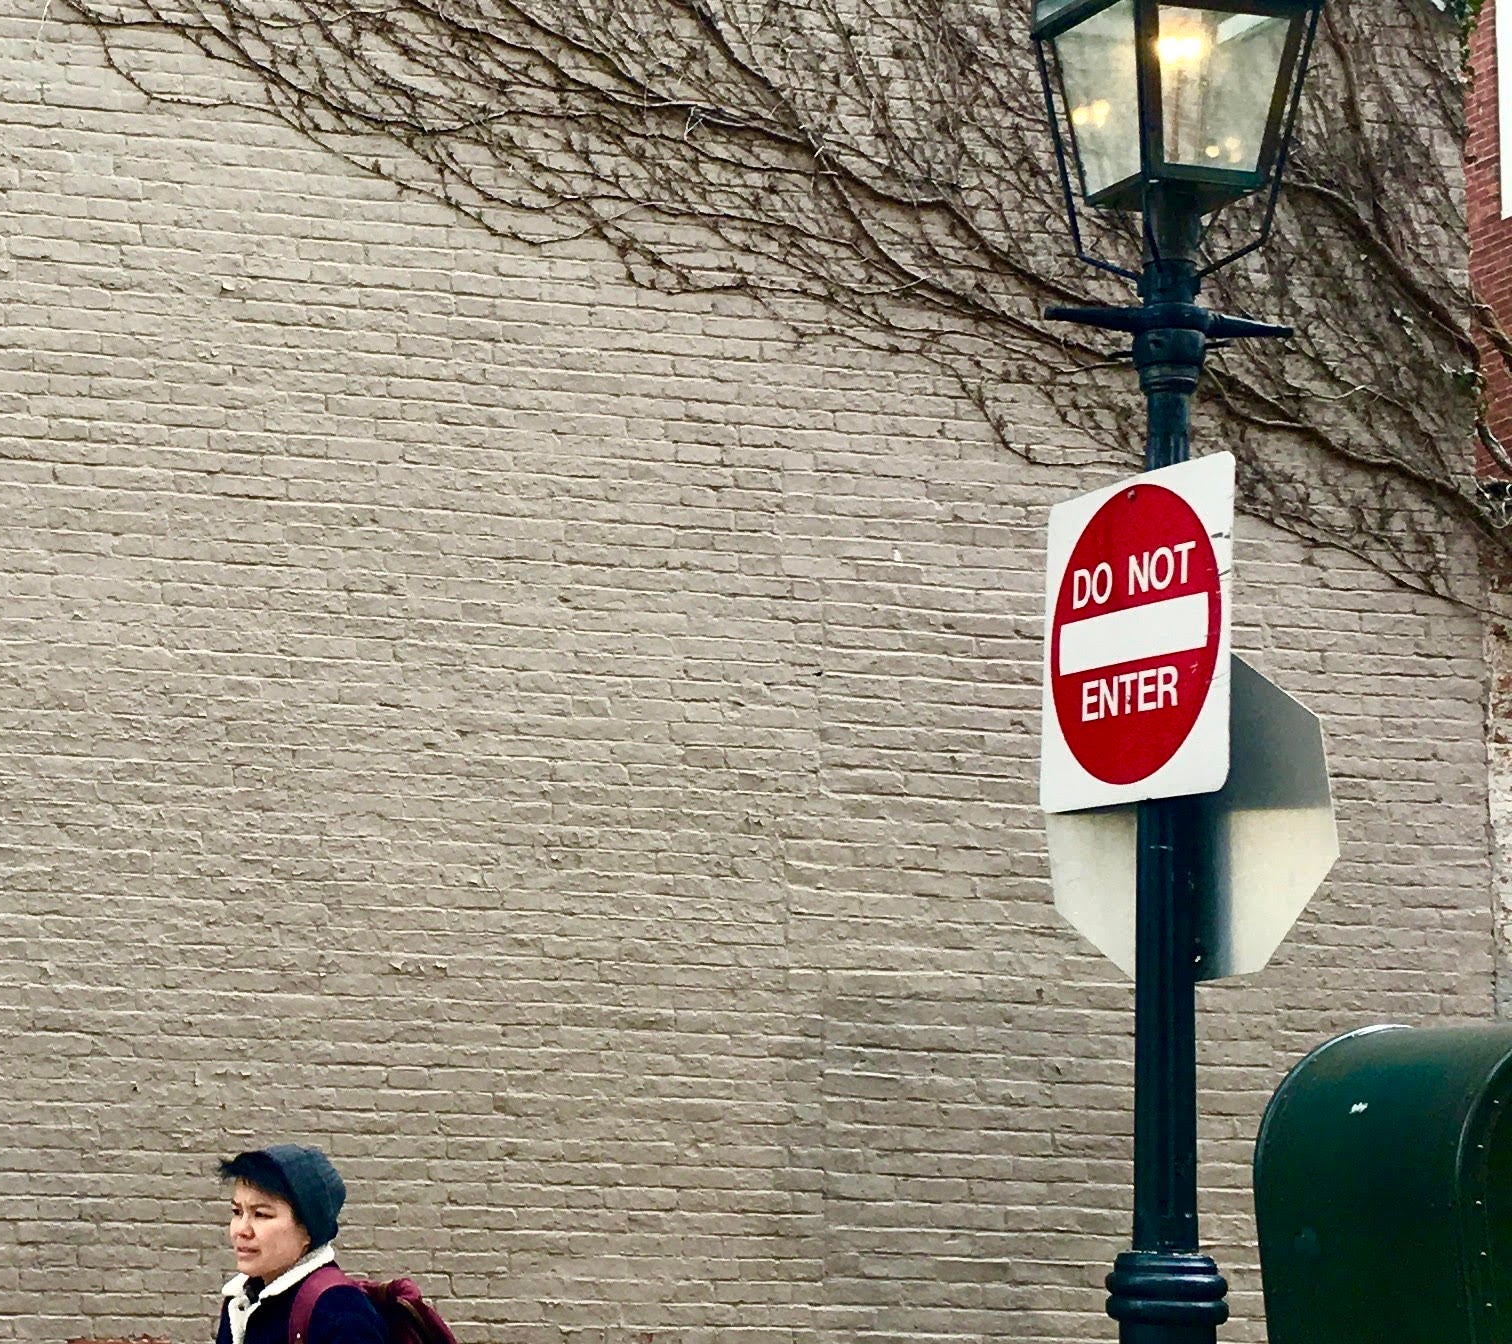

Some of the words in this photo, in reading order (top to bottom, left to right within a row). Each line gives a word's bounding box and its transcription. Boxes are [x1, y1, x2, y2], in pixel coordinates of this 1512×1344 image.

[1072, 561, 1113, 610] DO
[1128, 541, 1196, 596] NOT
[1081, 665, 1179, 723] ENTER
